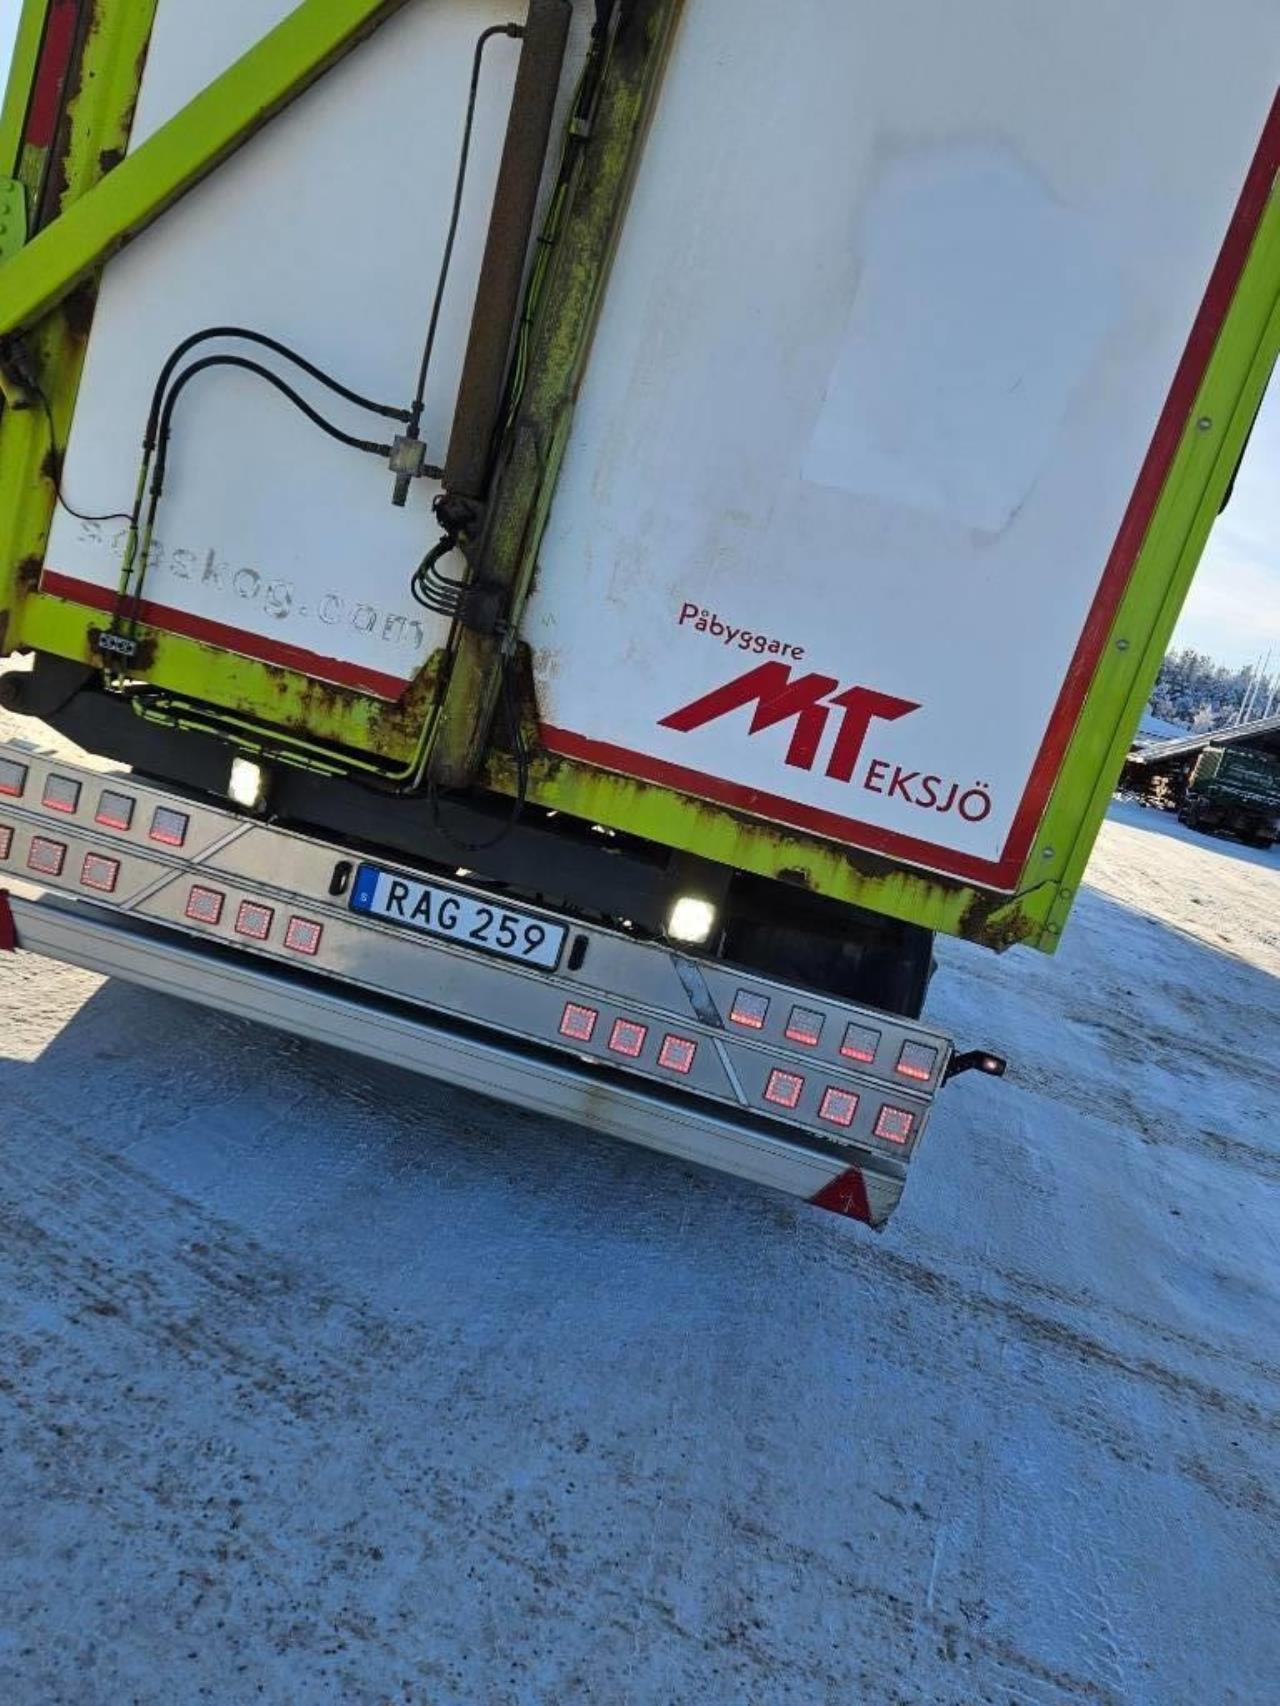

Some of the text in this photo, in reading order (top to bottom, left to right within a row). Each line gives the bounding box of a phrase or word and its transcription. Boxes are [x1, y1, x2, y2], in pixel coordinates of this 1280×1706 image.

[678, 602, 805, 660] Påbyggare
[656, 660, 992, 822] MT EKSJÖ
[360, 892, 368, 902] S
[385, 880, 546, 955] RAG 259
